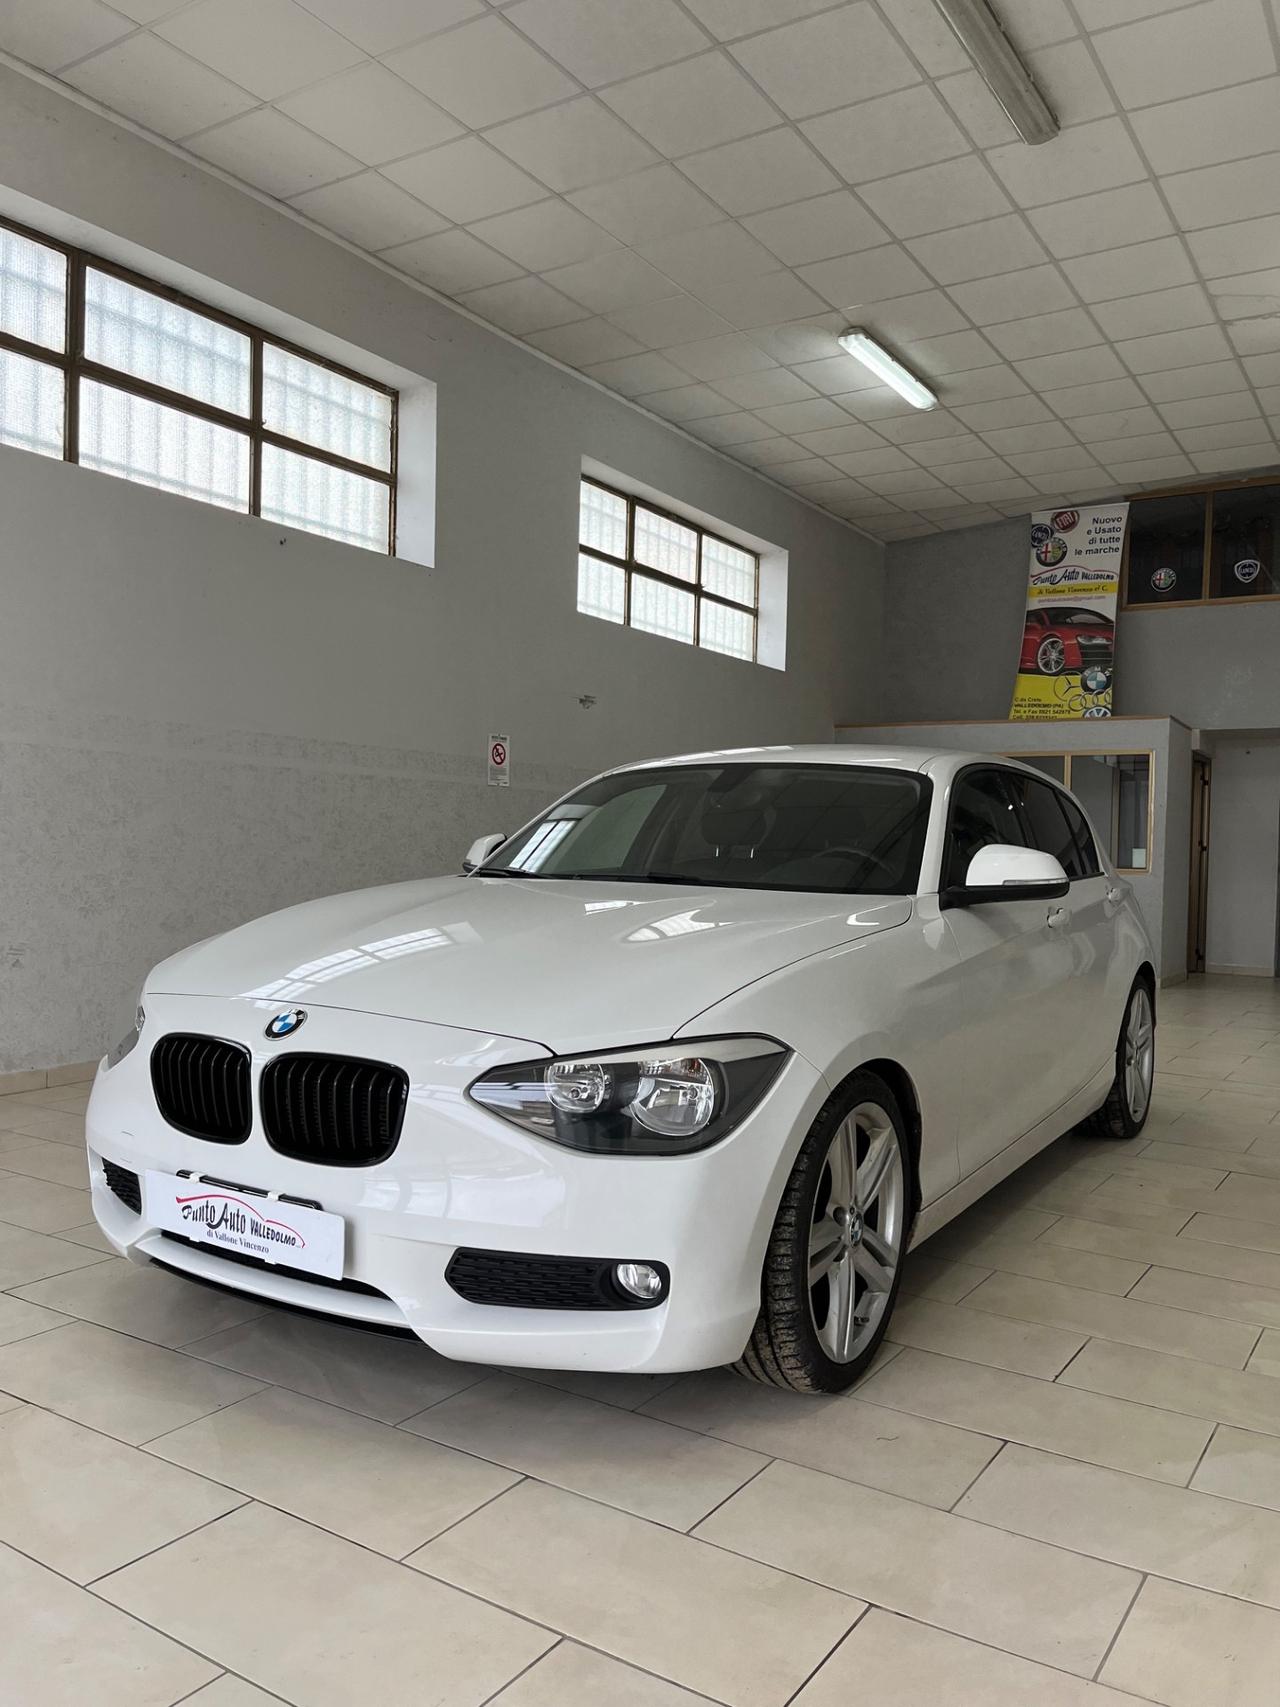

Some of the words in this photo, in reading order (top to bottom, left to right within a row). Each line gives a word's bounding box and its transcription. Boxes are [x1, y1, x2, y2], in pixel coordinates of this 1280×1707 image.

[1056, 511, 1075, 528] FIAT
[1092, 516, 1123, 525] Nuovo
[1094, 526, 1122, 534] Usato
[1099, 536, 1121, 544] tutte
[1085, 545, 1120, 555] marche
[1033, 574, 1058, 585] Punto
[1049, 568, 1080, 585] Auto
[182, 1200, 216, 1222] Punto
[206, 1203, 246, 1235] Auto
[250, 1218, 296, 1247] VALLEDOLMO
[206, 1230, 214, 1238] di
[214, 1231, 238, 1246] Vallone
[239, 1237, 270, 1254] Vincenzo
